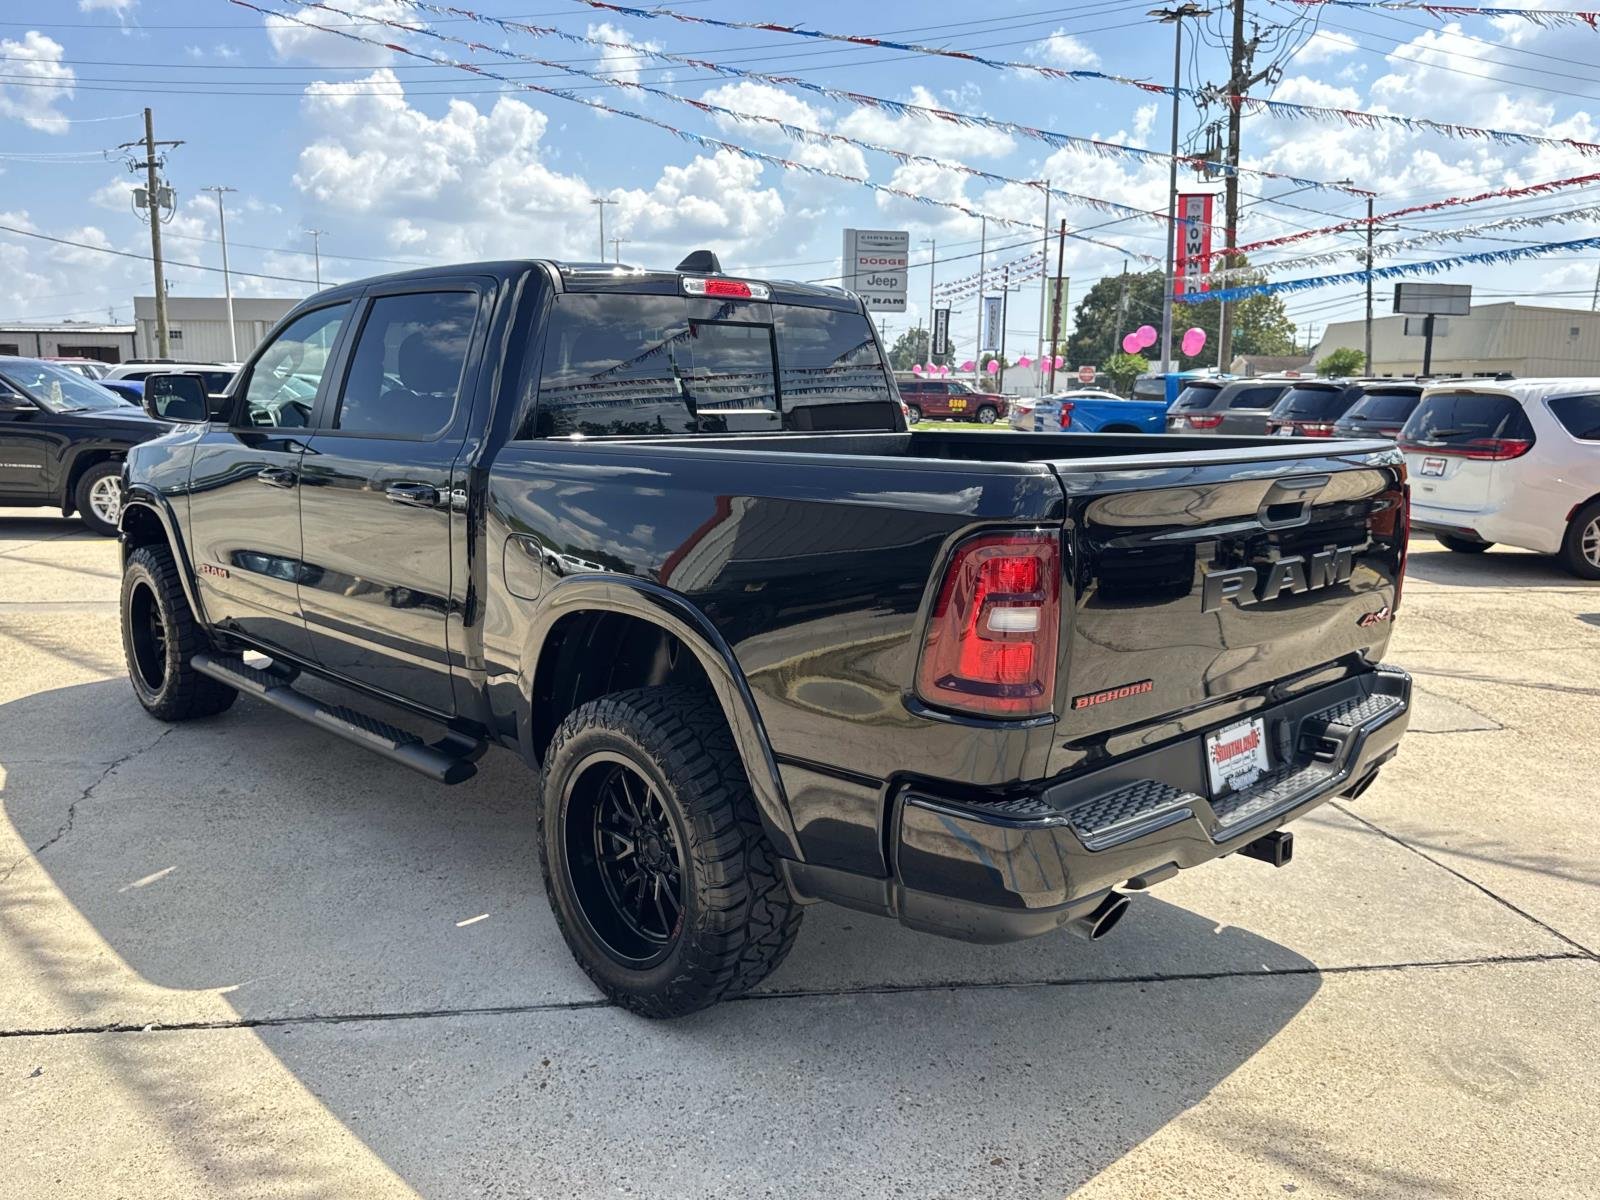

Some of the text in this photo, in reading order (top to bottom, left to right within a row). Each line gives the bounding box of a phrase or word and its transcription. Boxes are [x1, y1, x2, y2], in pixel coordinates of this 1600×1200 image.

[859, 257, 906, 266] DODGE
[867, 274, 898, 288] Jeep
[872, 297, 905, 305] RAM
[201, 563, 230, 579] RAM
[1201, 546, 1352, 613] RAM
[1072, 679, 1153, 710] BIGHORN
